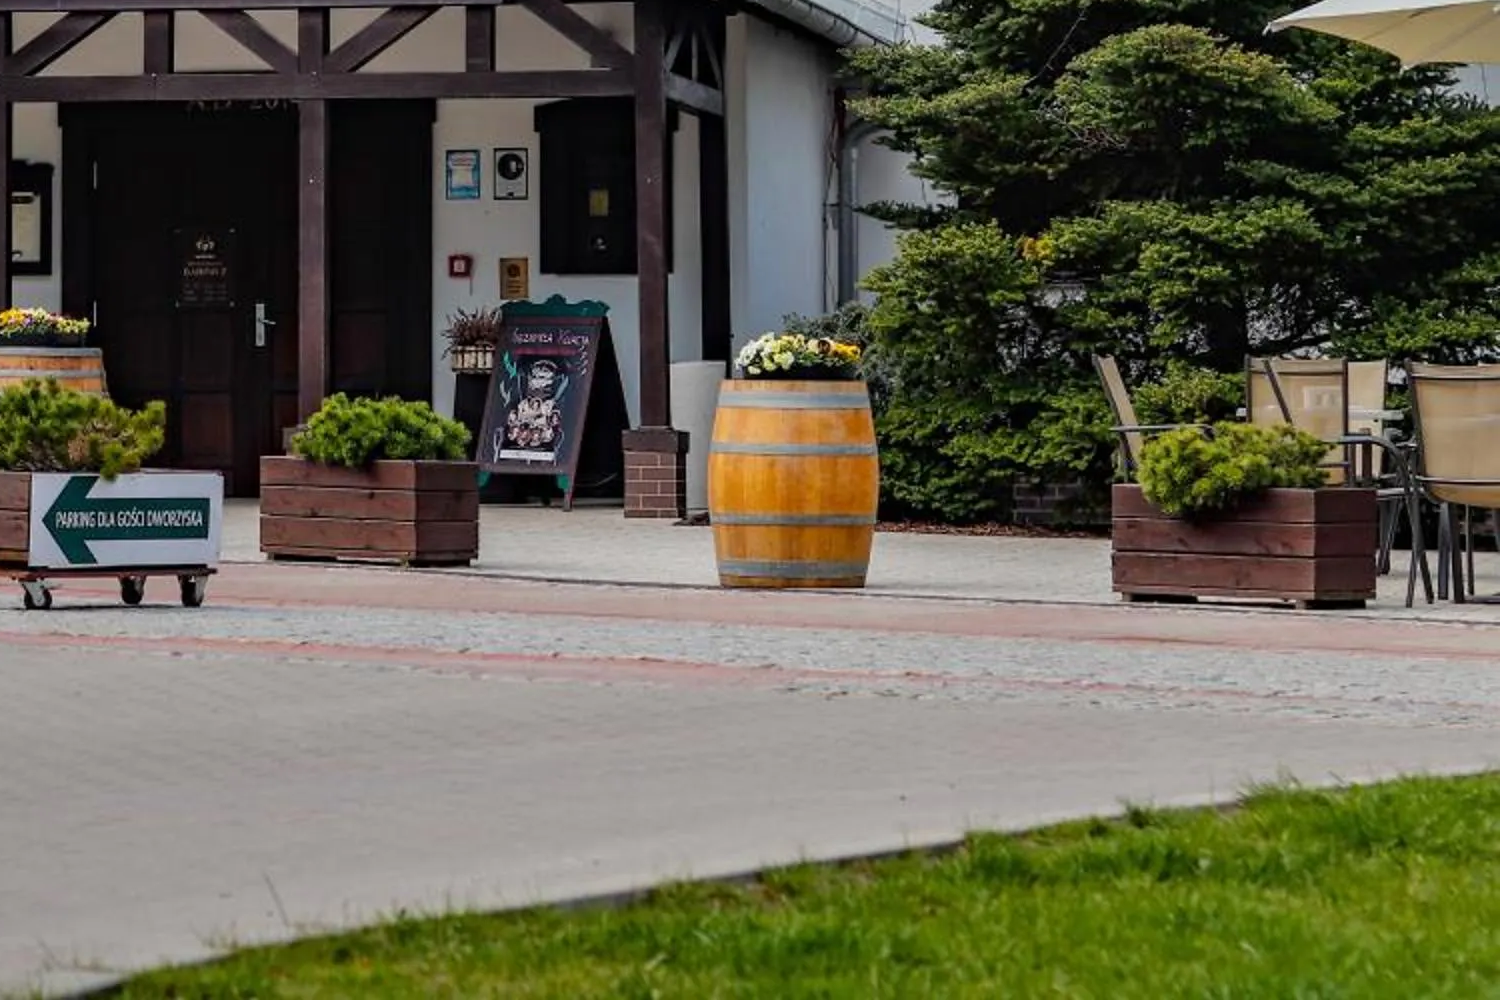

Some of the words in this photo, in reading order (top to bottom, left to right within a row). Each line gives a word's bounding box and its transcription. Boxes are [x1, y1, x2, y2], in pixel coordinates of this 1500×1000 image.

[55, 511, 96, 529] PARKING
[98, 511, 115, 528] DLA
[117, 506, 145, 528] GOŚCI
[147, 509, 204, 528] DWORZYSKA
